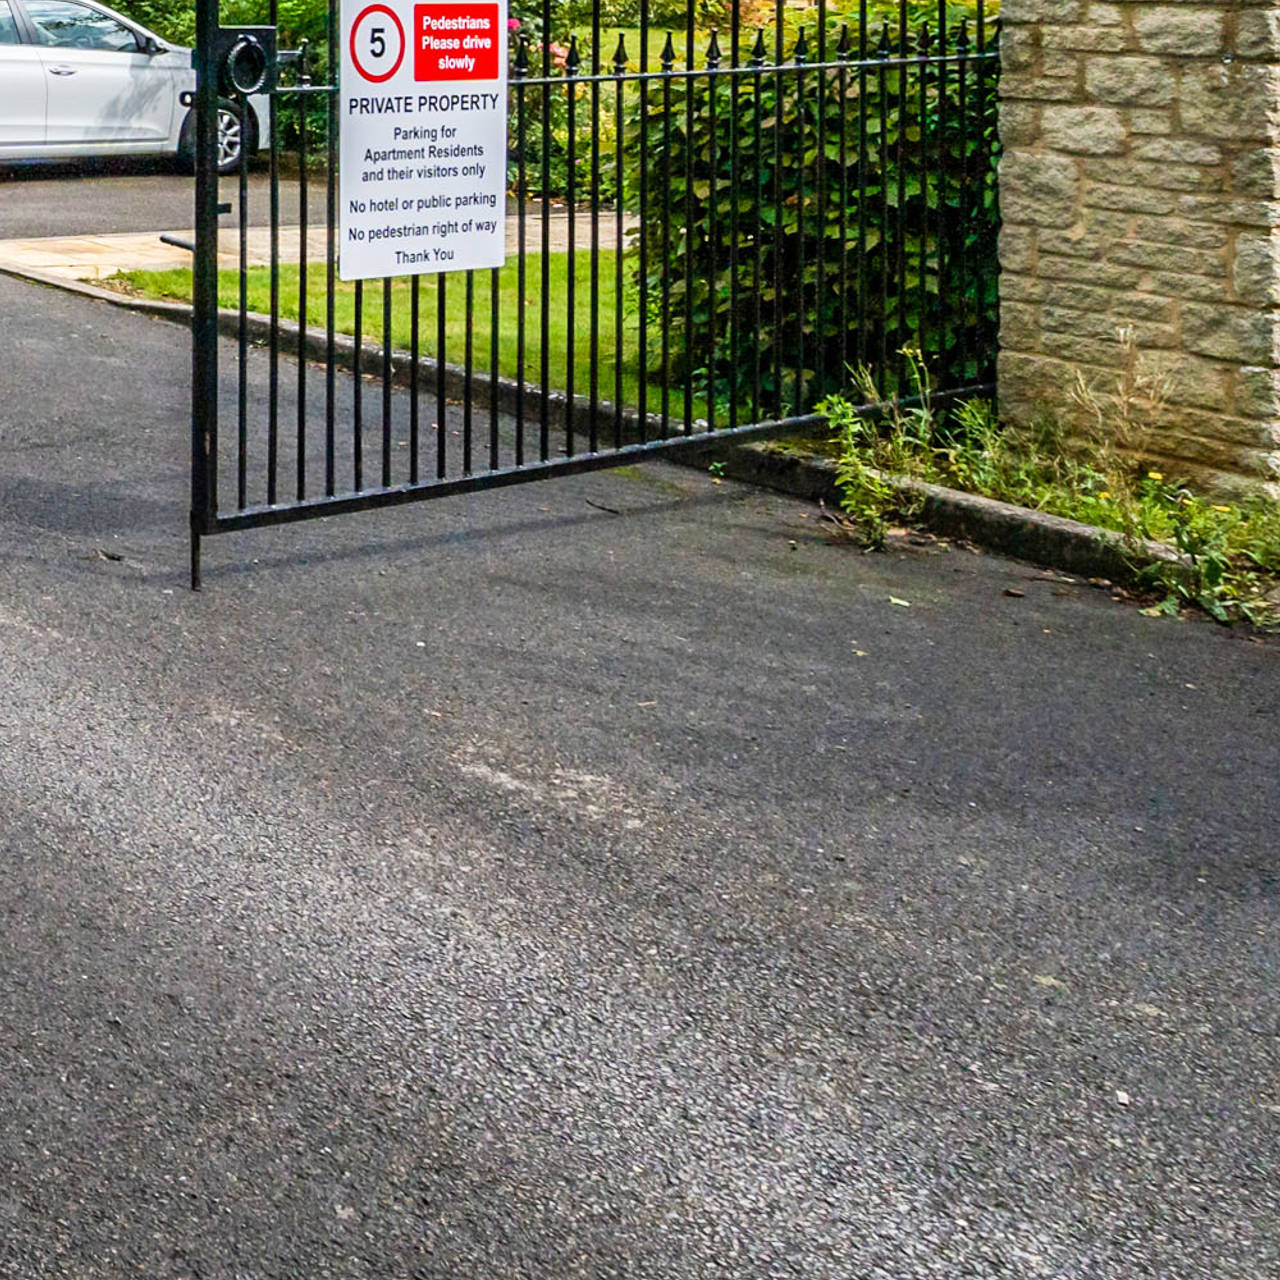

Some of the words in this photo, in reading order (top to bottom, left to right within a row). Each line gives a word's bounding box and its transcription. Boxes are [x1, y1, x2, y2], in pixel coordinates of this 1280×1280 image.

[423, 16, 490, 30] Pedestrians
[370, 28, 385, 58] 5
[422, 36, 460, 50] Please
[463, 34, 491, 49] drive
[439, 55, 475, 71] slowly
[349, 96, 413, 114] PRIVATE
[418, 94, 499, 112] PROPERTY
[394, 127, 437, 142] Parking
[441, 125, 456, 138] for
[364, 148, 424, 165] Apartment
[429, 144, 484, 159] Residents
[362, 167, 383, 182] and
[388, 167, 413, 180] their
[417, 165, 458, 179] visitors
[462, 163, 485, 179] only
[350, 200, 366, 213] No
[370, 198, 398, 212] hotel
[402, 199, 414, 210] or
[417, 195, 451, 212] public
[455, 192, 496, 209] parking
[349, 228, 364, 241] No
[369, 222, 428, 243] pedestrian
[432, 221, 458, 238] right
[462, 219, 473, 232] of
[476, 220, 497, 234] way
[396, 250, 430, 264] Thank
[433, 248, 454, 261] You
